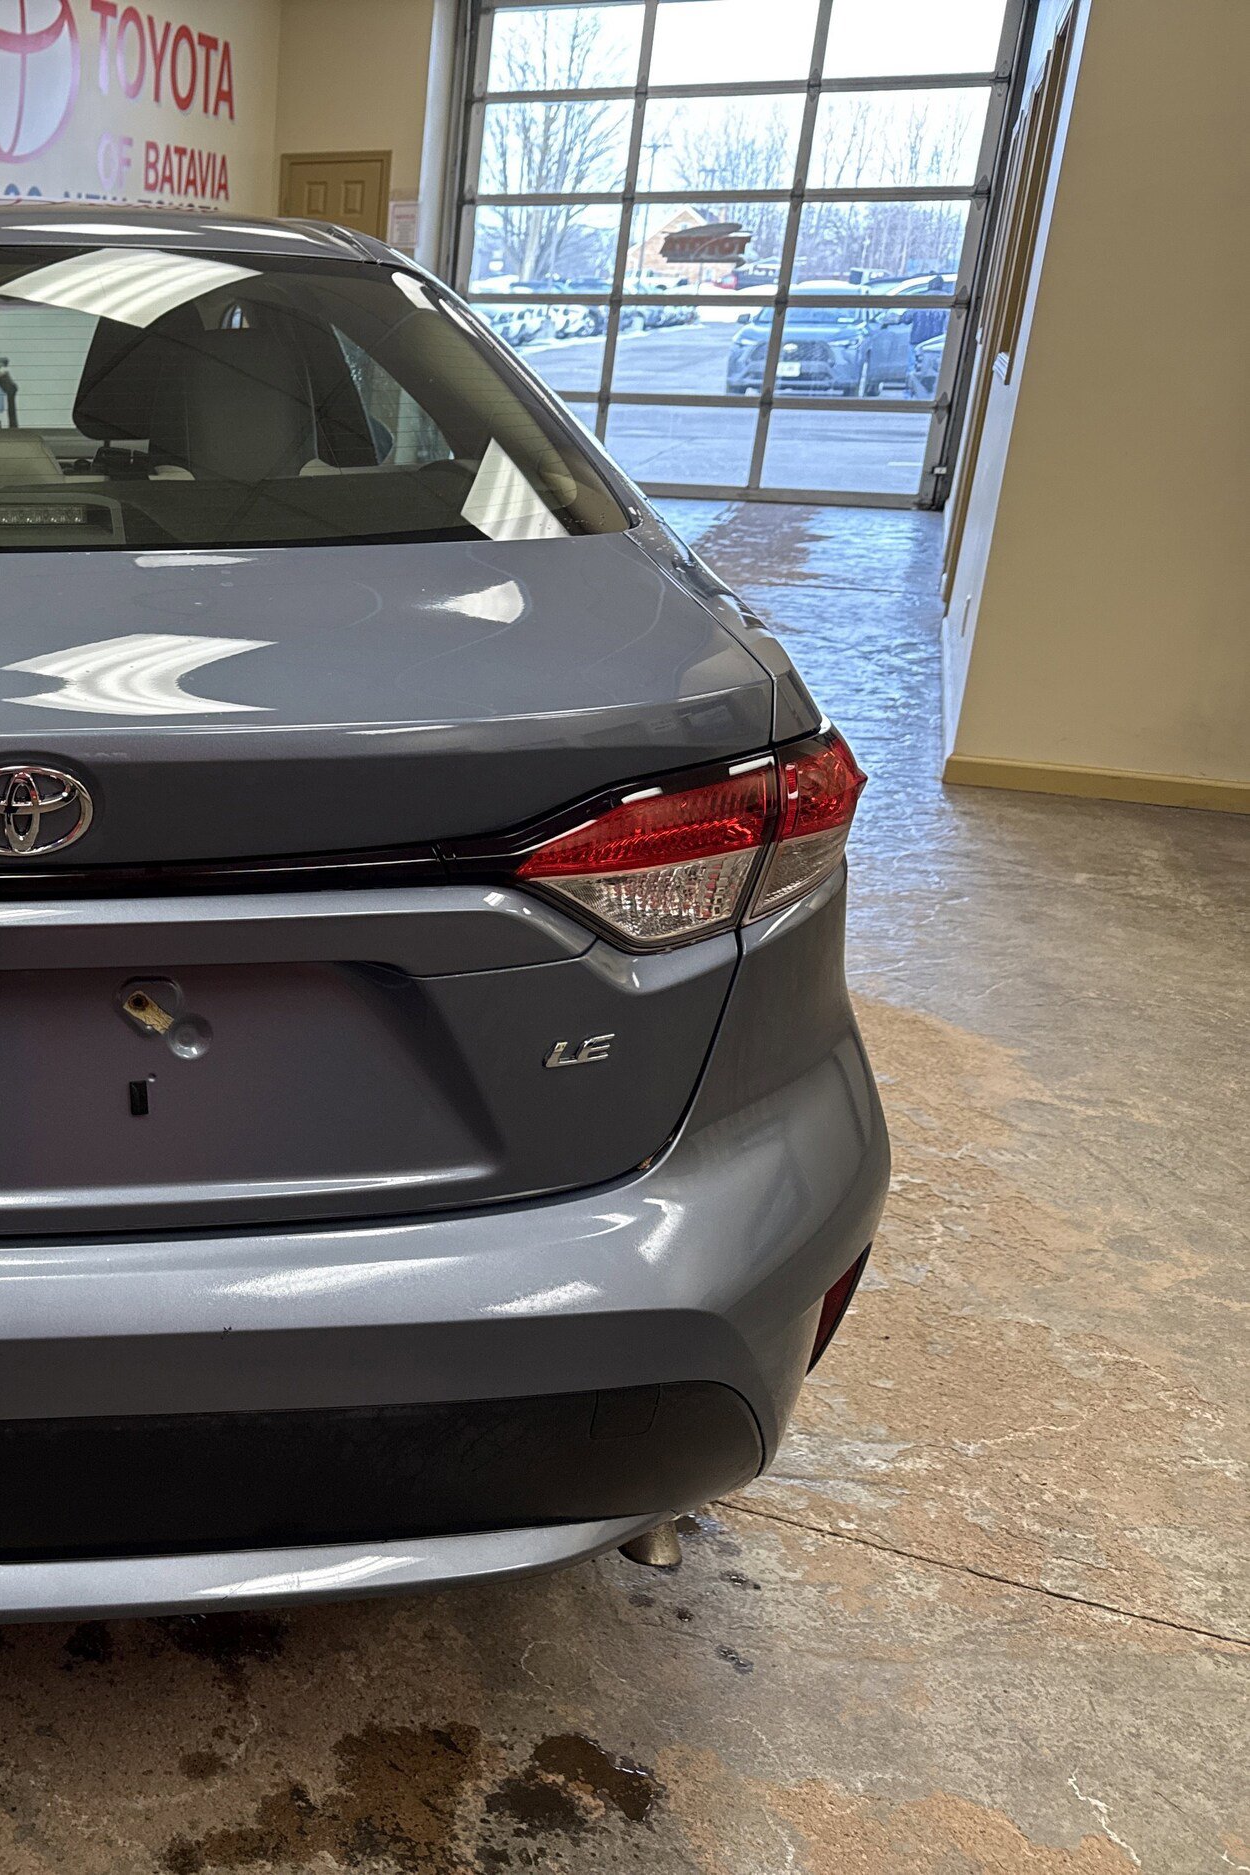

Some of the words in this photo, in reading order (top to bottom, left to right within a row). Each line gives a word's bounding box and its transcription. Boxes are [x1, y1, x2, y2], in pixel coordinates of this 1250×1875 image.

[90, 0, 235, 121] TOYOTA
[97, 131, 134, 191] OF
[143, 140, 230, 201] BATAVIA
[544, 1033, 616, 1068] LE
